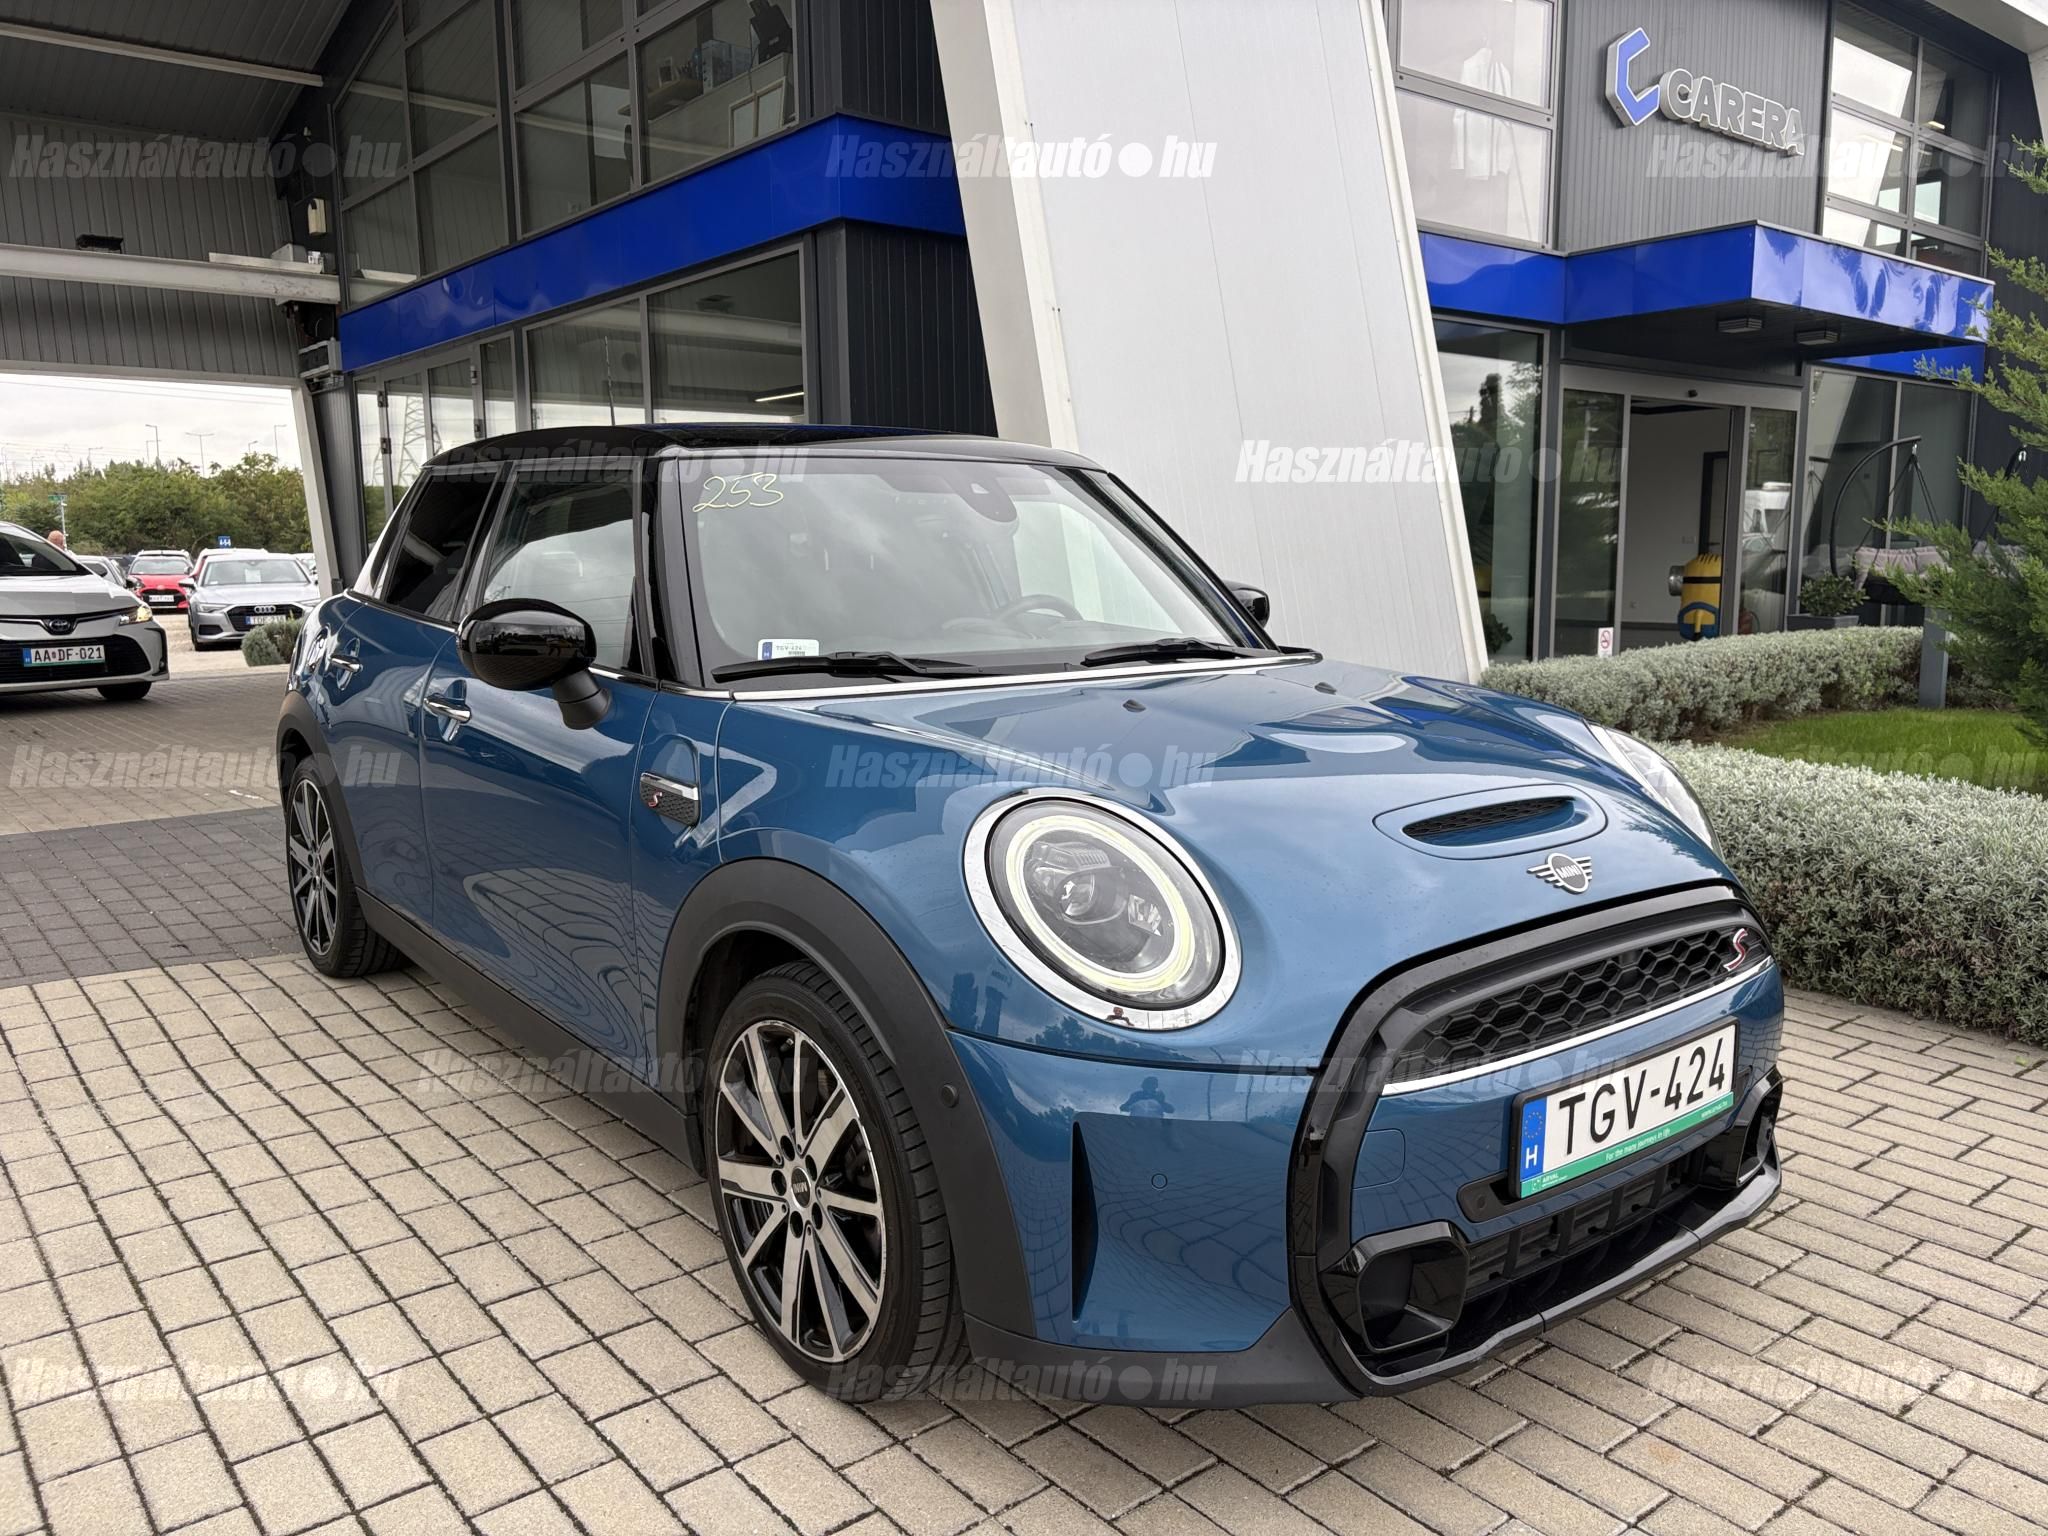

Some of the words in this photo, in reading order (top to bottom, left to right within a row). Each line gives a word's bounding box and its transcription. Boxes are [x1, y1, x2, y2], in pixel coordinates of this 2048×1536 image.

[1663, 67, 1805, 155] CARERA
[692, 471, 784, 513] 253
[1555, 864, 1582, 879] MINI
[1558, 1036, 1726, 1156] TGV-424
[1524, 1144, 1538, 1169] H
